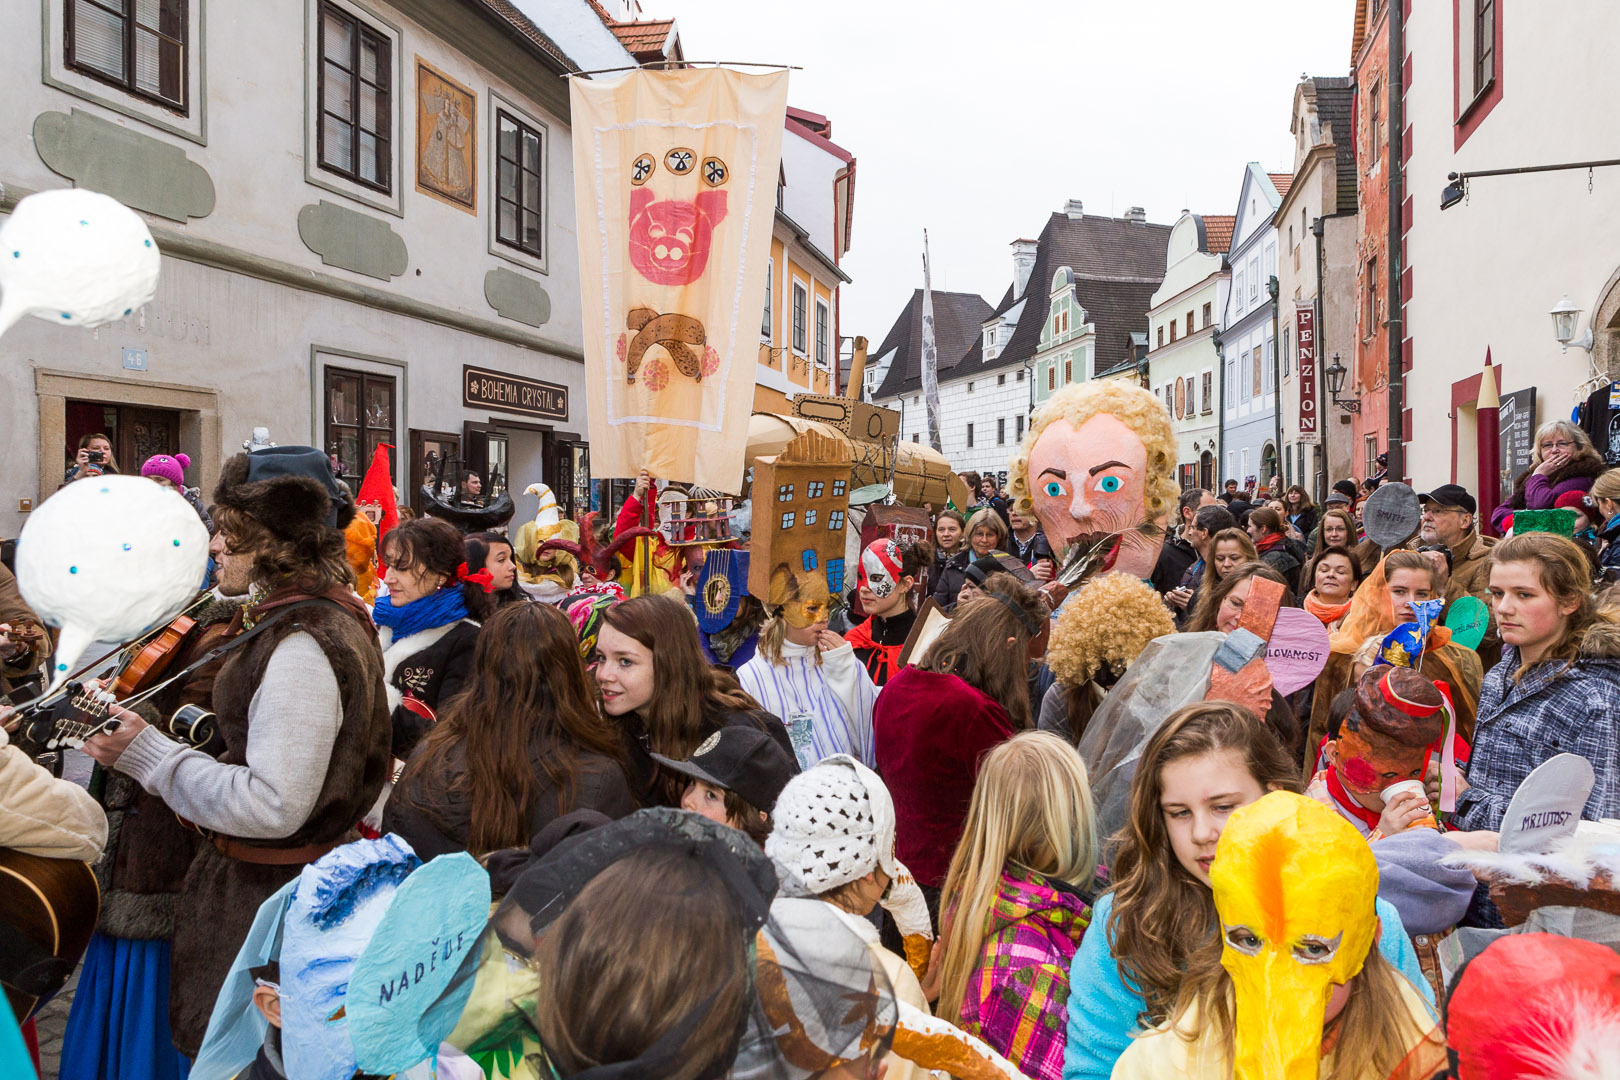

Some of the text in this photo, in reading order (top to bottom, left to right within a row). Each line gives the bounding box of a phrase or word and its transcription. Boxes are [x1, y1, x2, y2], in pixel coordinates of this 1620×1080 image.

[481, 379, 556, 411] BOHEMIA CRYSTAL
[1299, 312, 1316, 429] PENZION
